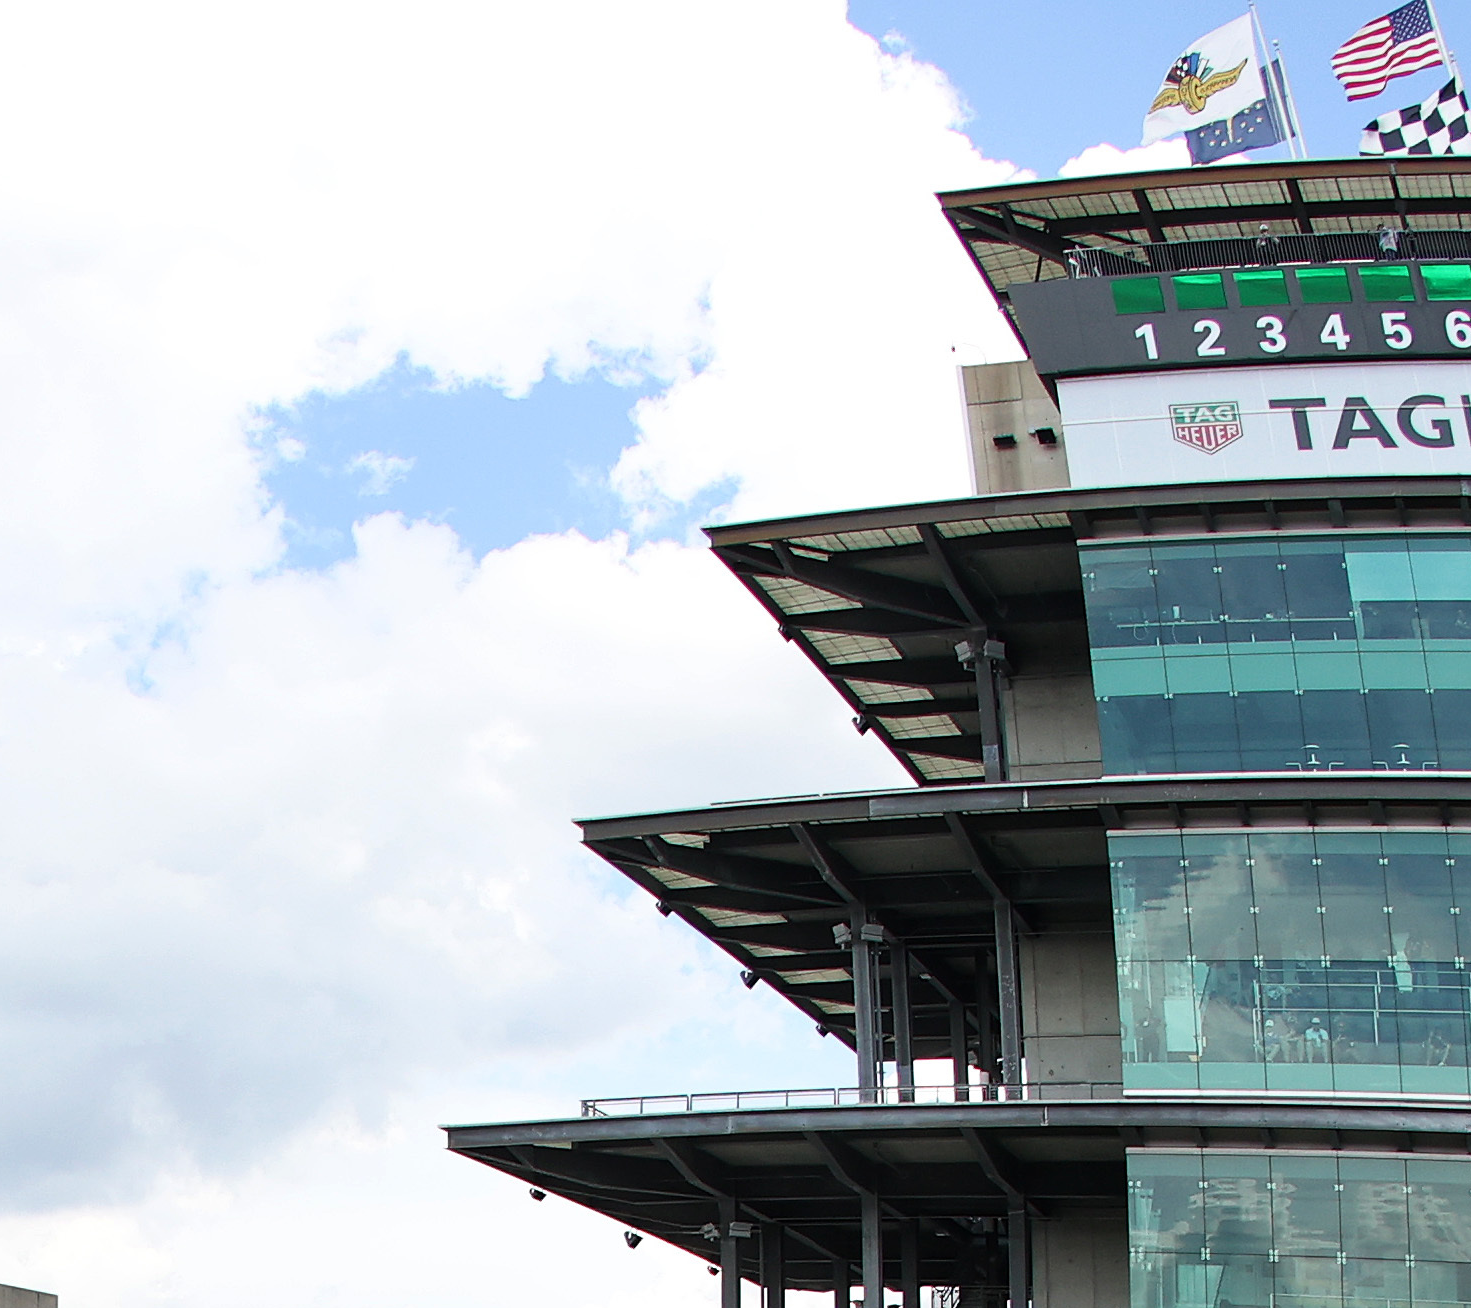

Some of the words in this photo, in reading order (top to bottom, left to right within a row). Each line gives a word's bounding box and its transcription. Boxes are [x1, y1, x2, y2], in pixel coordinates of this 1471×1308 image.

[1135, 323, 1158, 359] 1
[1194, 319, 1225, 356] 2
[1255, 316, 1287, 353] 3
[1319, 313, 1350, 350] 4
[1381, 312, 1412, 349] 5
[1177, 405, 1233, 421] TAG
[1176, 424, 1240, 450] HEUER
